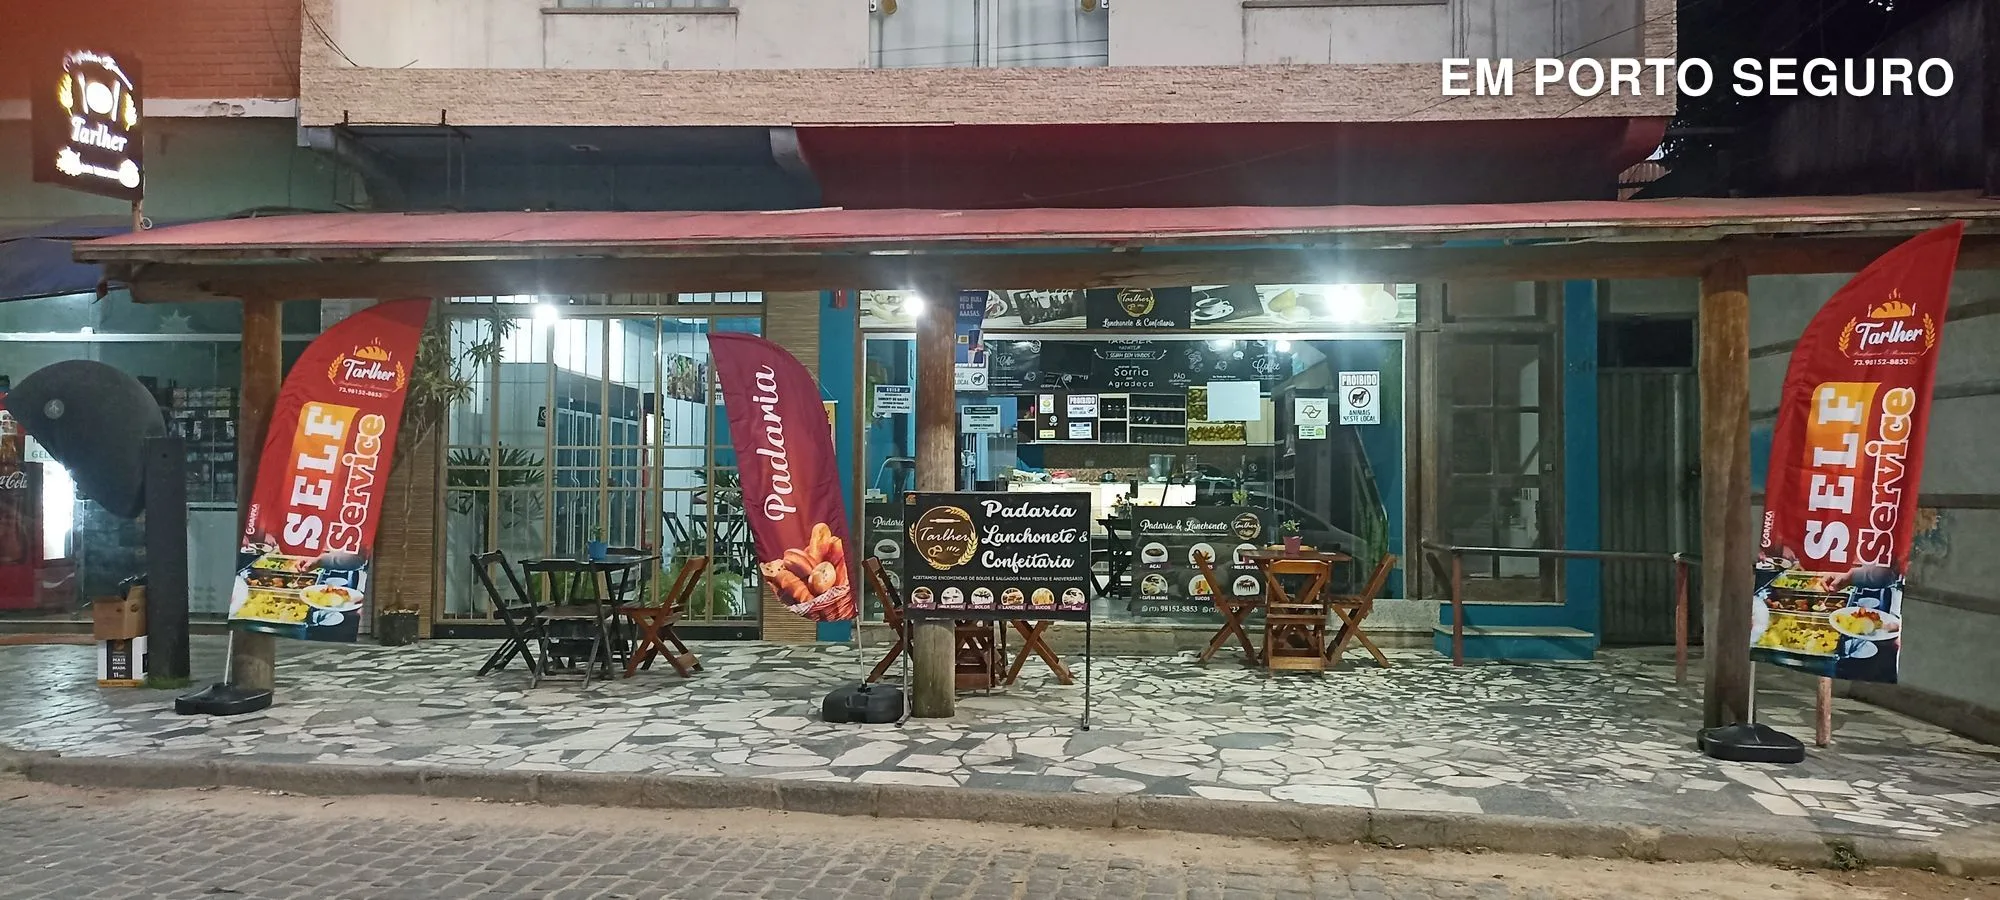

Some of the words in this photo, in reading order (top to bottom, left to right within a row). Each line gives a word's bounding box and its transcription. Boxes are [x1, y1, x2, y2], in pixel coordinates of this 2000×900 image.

[71, 116, 127, 152] Tarlher
[1135, 318, 1142, 327] &
[1855, 320, 1923, 350] Tarlher
[343, 358, 395, 381] Tarlher
[1114, 367, 1149, 377] Sorria
[1341, 374, 1378, 386] PROIBIDO
[1108, 380, 1154, 389] Agradeça
[31, 450, 53, 459] GEL
[752, 364, 797, 522] Padaria
[284, 406, 344, 550] SELF
[327, 414, 385, 555] Service
[1804, 387, 1864, 564] SELF
[1857, 386, 1916, 568] Service
[981, 499, 1077, 518] Padaria
[919, 526, 971, 543] Tarlher
[981, 524, 1076, 547] Lanchonete
[1078, 530, 1089, 543] &
[1140, 519, 1175, 531] Padaria
[1176, 520, 1183, 531] &
[1184, 520, 1228, 533] Lanchonete
[981, 550, 1075, 573] Confeitaria
